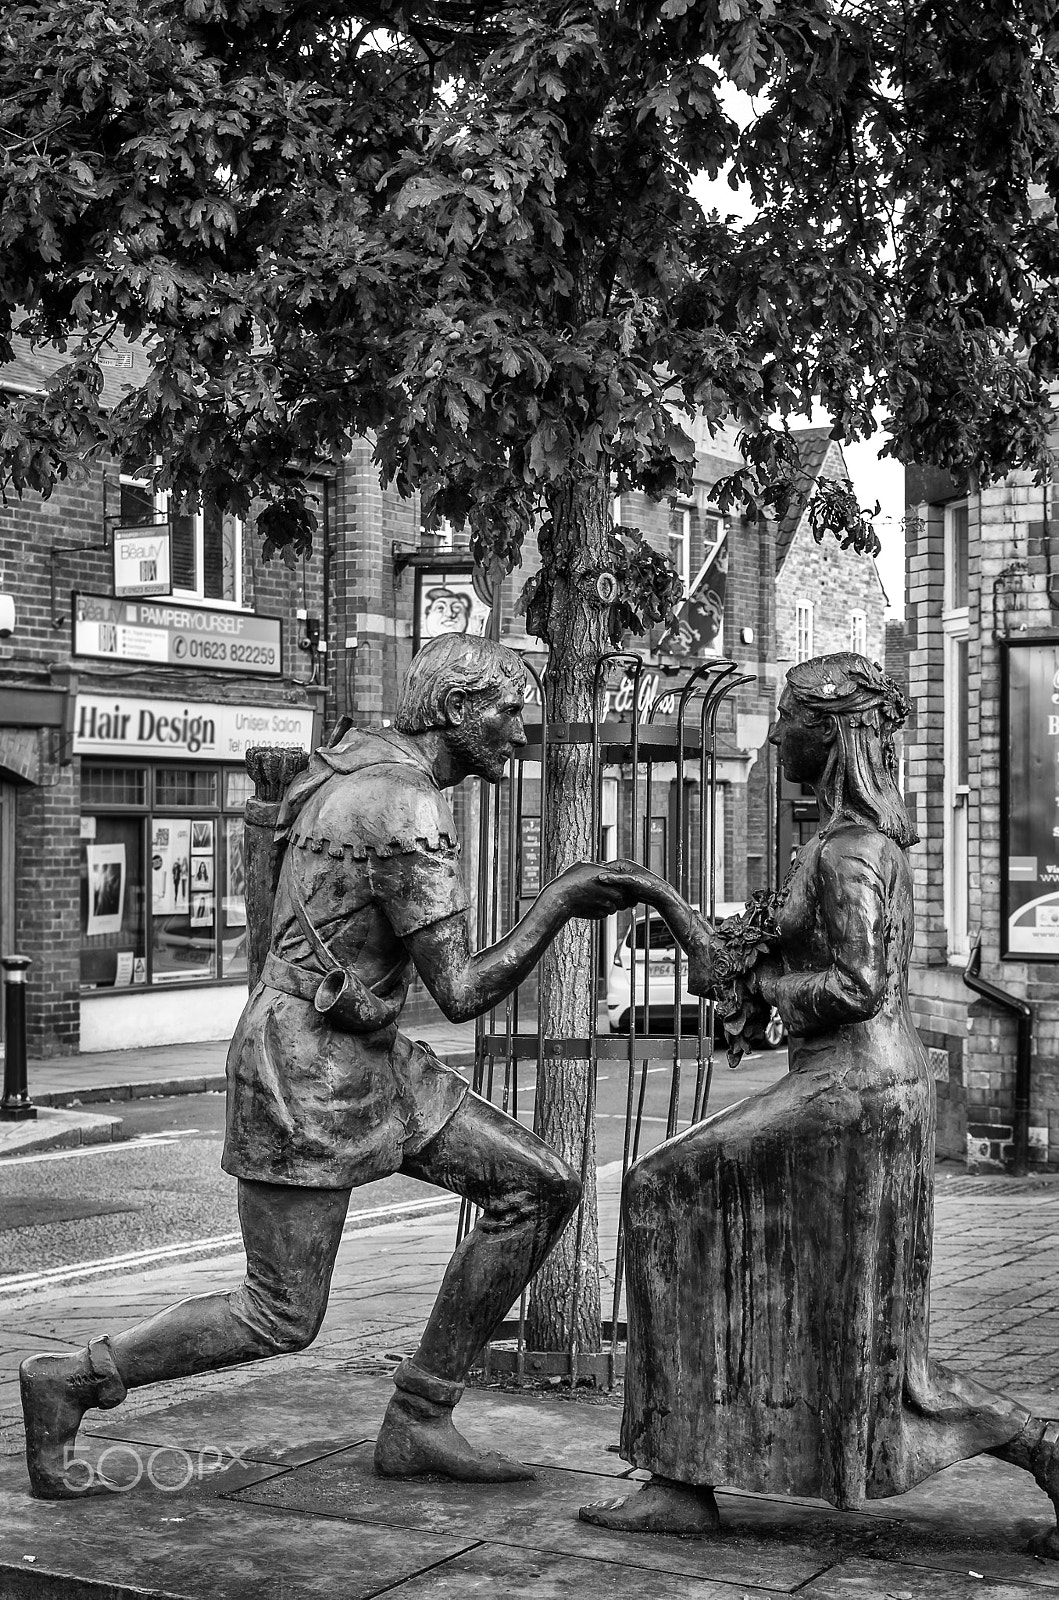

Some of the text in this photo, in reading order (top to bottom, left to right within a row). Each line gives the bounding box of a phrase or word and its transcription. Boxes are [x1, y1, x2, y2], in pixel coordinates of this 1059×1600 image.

[190, 639, 275, 665] 01623 822259
[77, 704, 215, 752] Hair Design
[235, 712, 302, 733] Unisex Salon
[228, 738, 243, 752] Tel:
